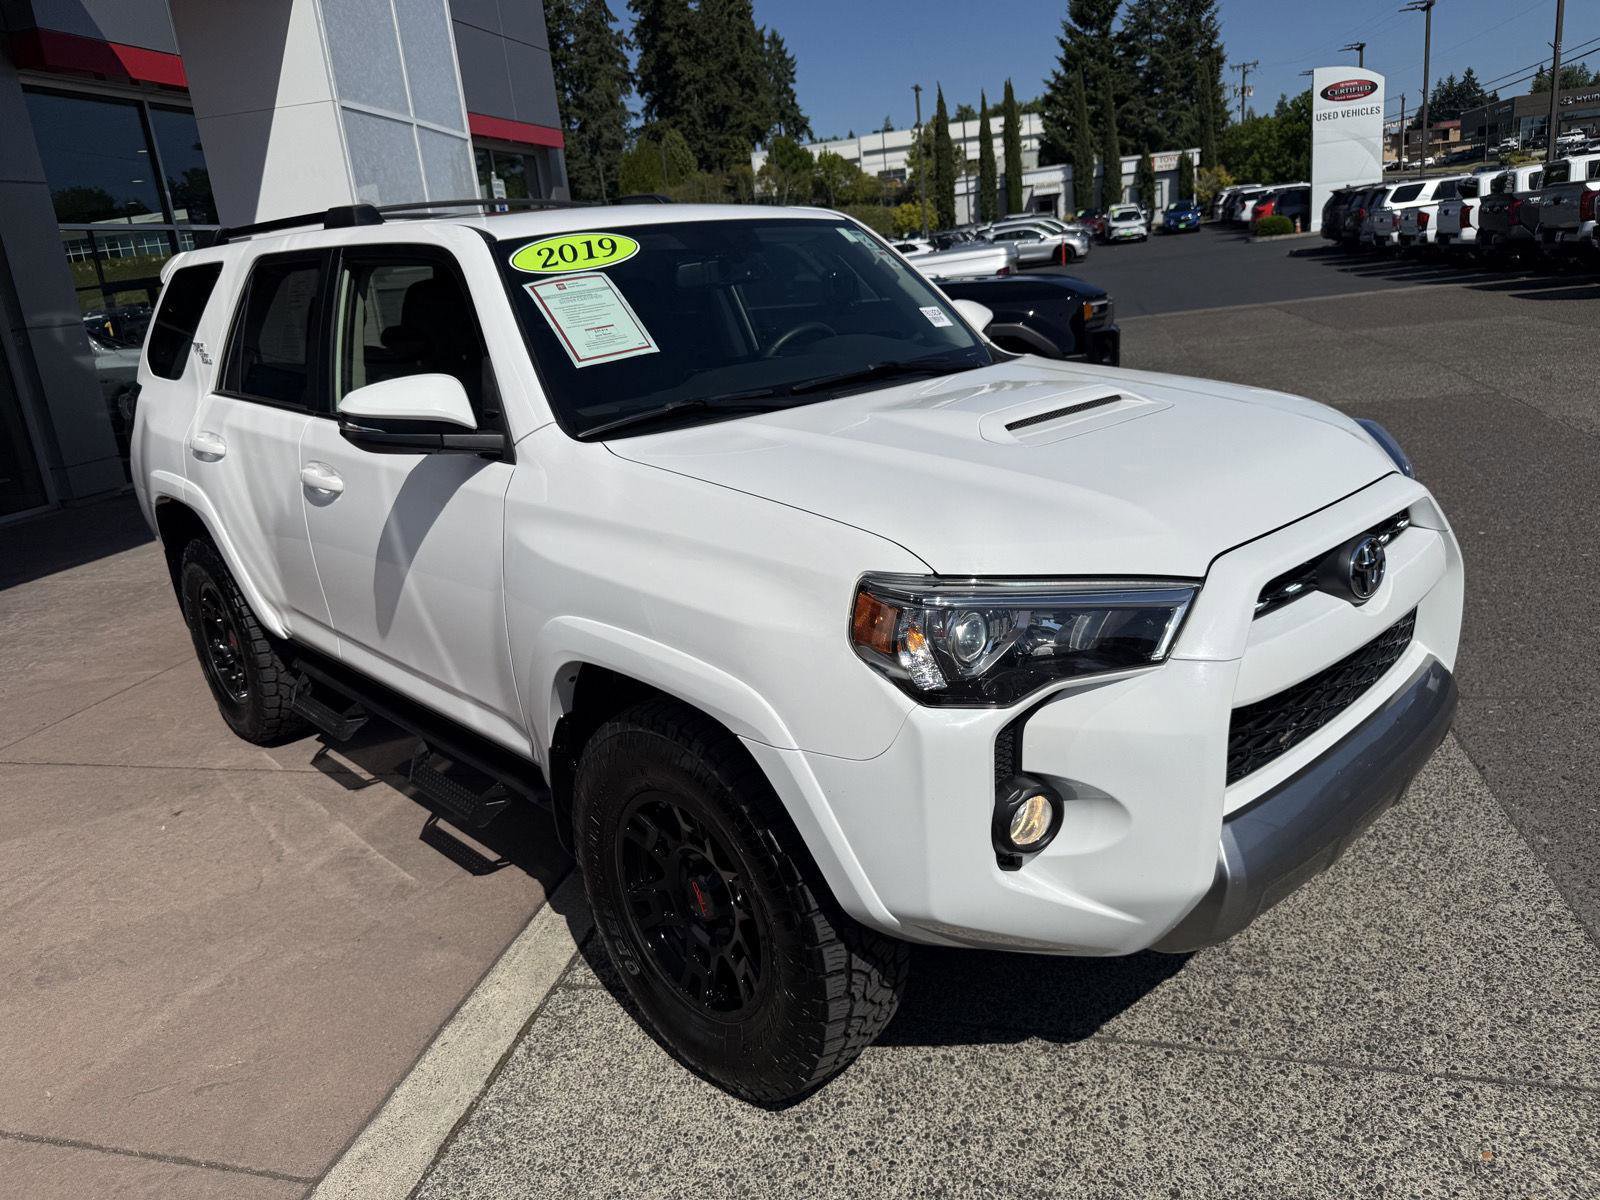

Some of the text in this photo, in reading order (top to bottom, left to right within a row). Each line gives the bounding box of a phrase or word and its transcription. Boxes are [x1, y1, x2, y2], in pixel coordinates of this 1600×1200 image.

[1316, 106, 1381, 122] USED VEHICLES
[537, 238, 617, 269] 2019
